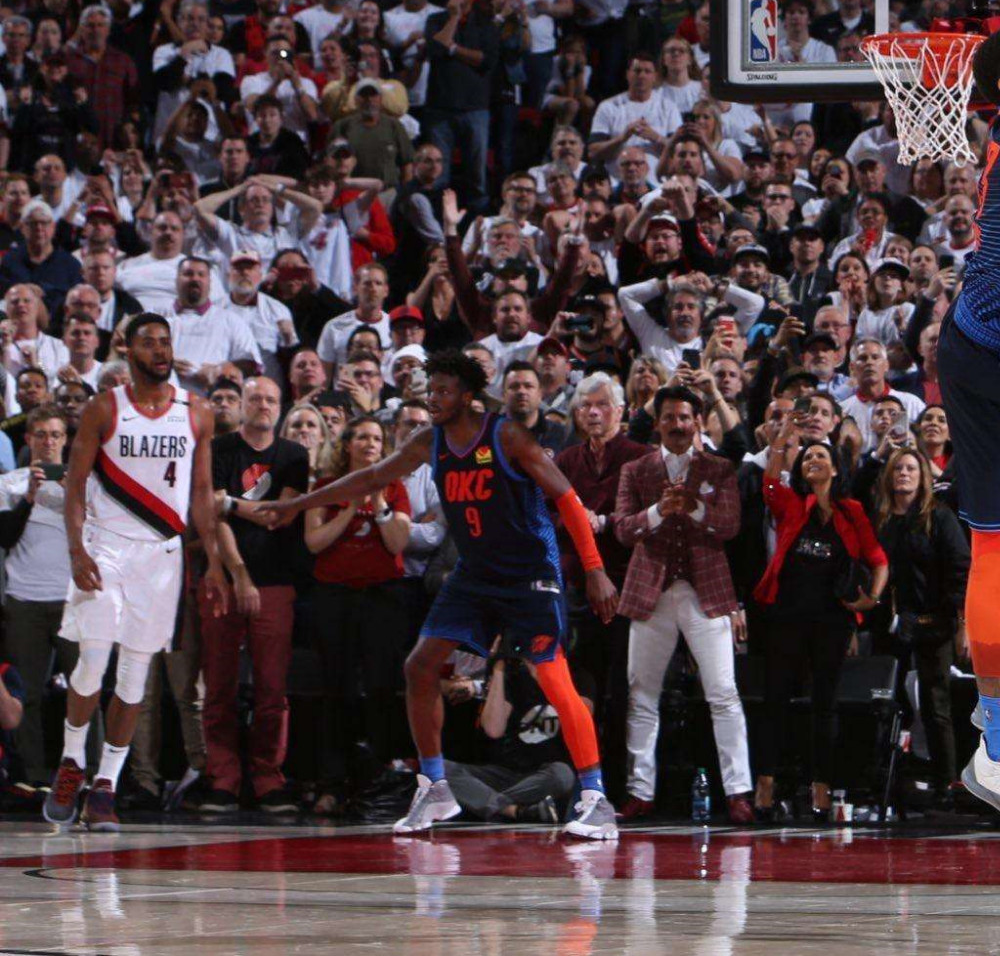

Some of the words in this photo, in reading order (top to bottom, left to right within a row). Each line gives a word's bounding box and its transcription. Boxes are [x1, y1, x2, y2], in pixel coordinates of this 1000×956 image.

[119, 435, 187, 458] BLAZERS
[163, 461, 177, 488] 4
[444, 468, 495, 503] OKC
[465, 506, 483, 537] 9
